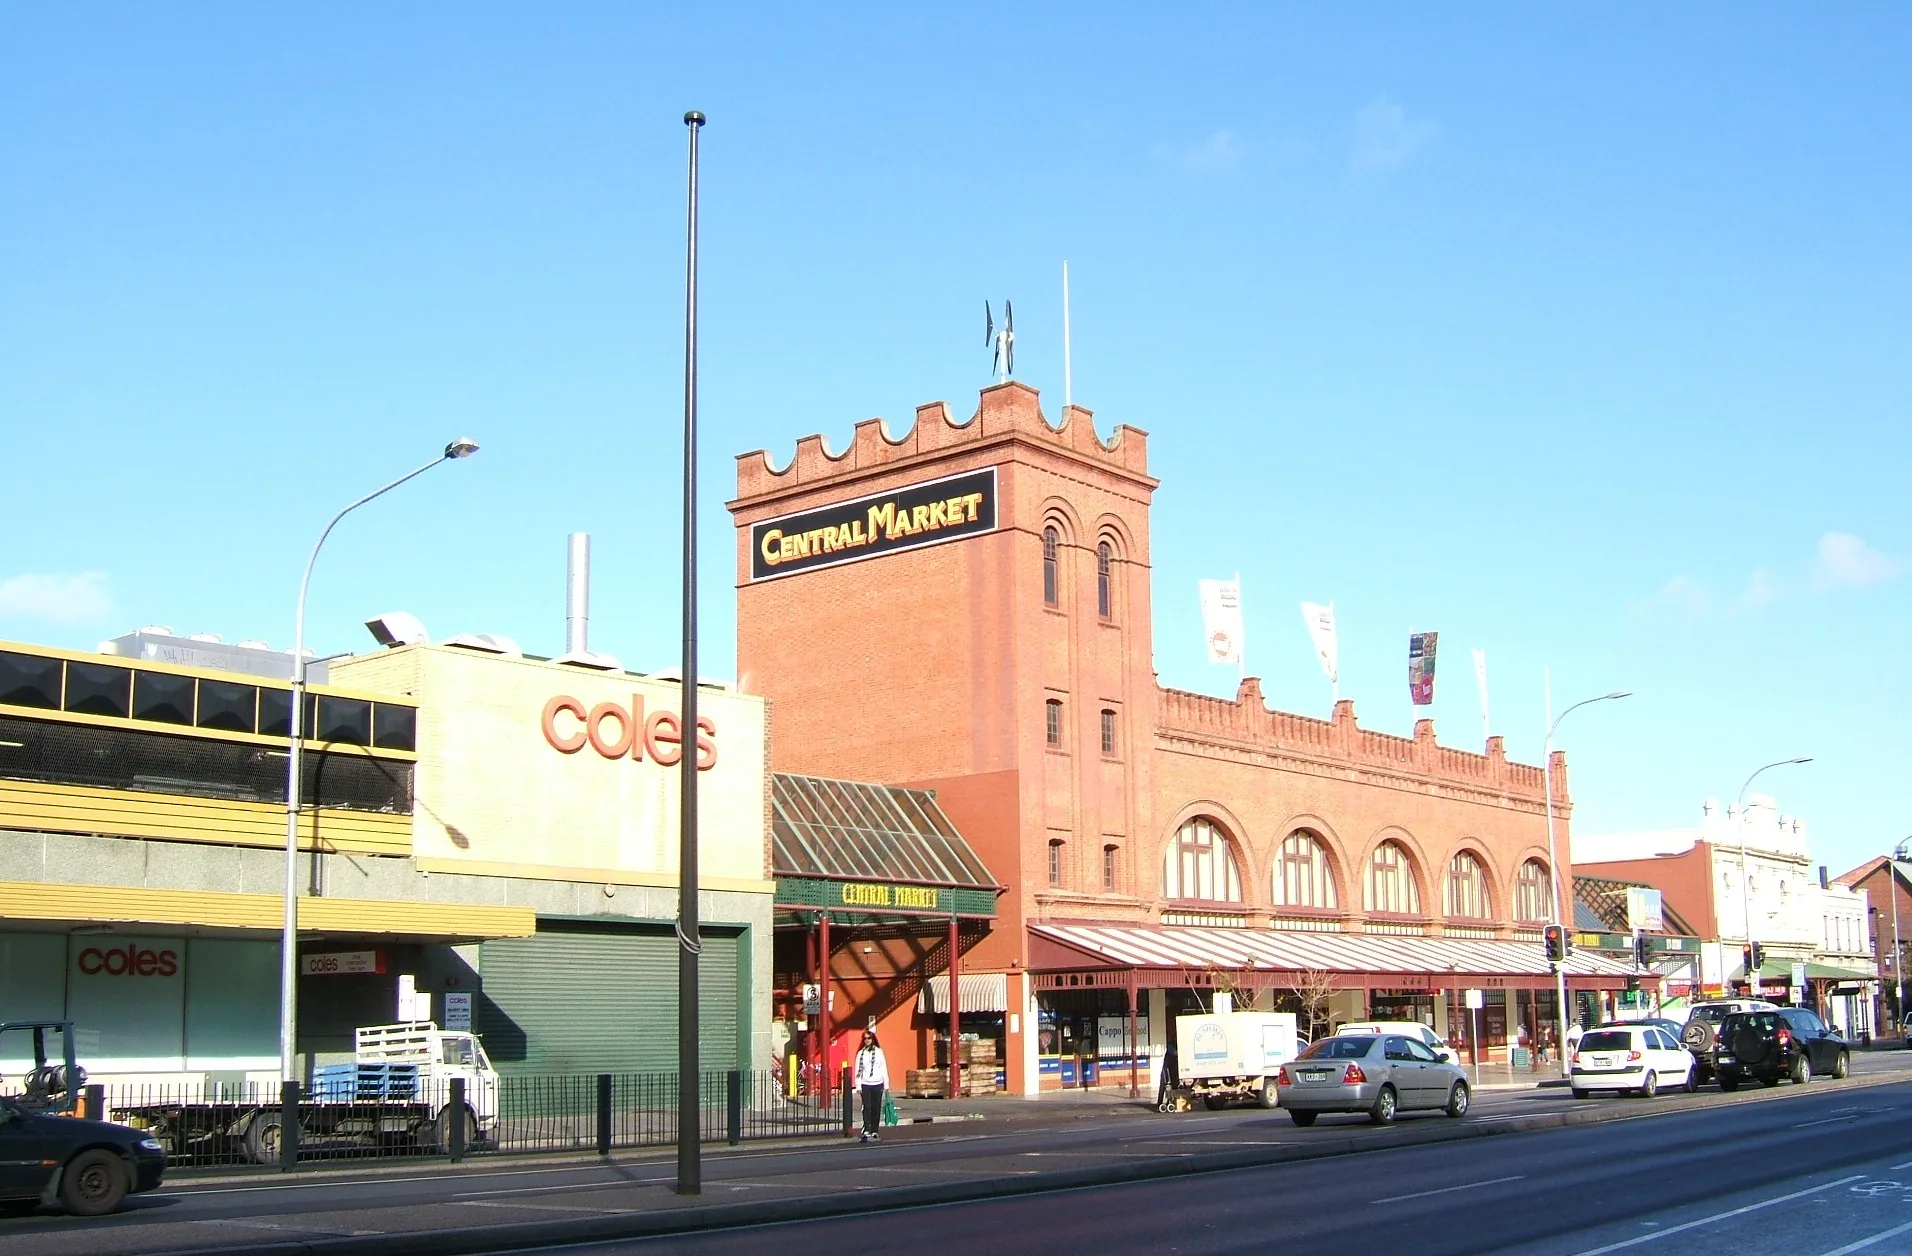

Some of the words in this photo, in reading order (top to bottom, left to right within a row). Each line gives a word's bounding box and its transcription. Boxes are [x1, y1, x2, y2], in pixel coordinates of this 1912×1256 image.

[760, 519, 866, 566] CENTRAL
[867, 491, 983, 543] MARKET
[541, 694, 718, 772] coles
[842, 883, 891, 906] CENTRAL
[894, 886, 938, 908] MARKET
[79, 944, 178, 976] coles
[310, 956, 338, 972] coles
[449, 996, 468, 1004] coles
[1099, 1025, 1122, 1038] Cappo
